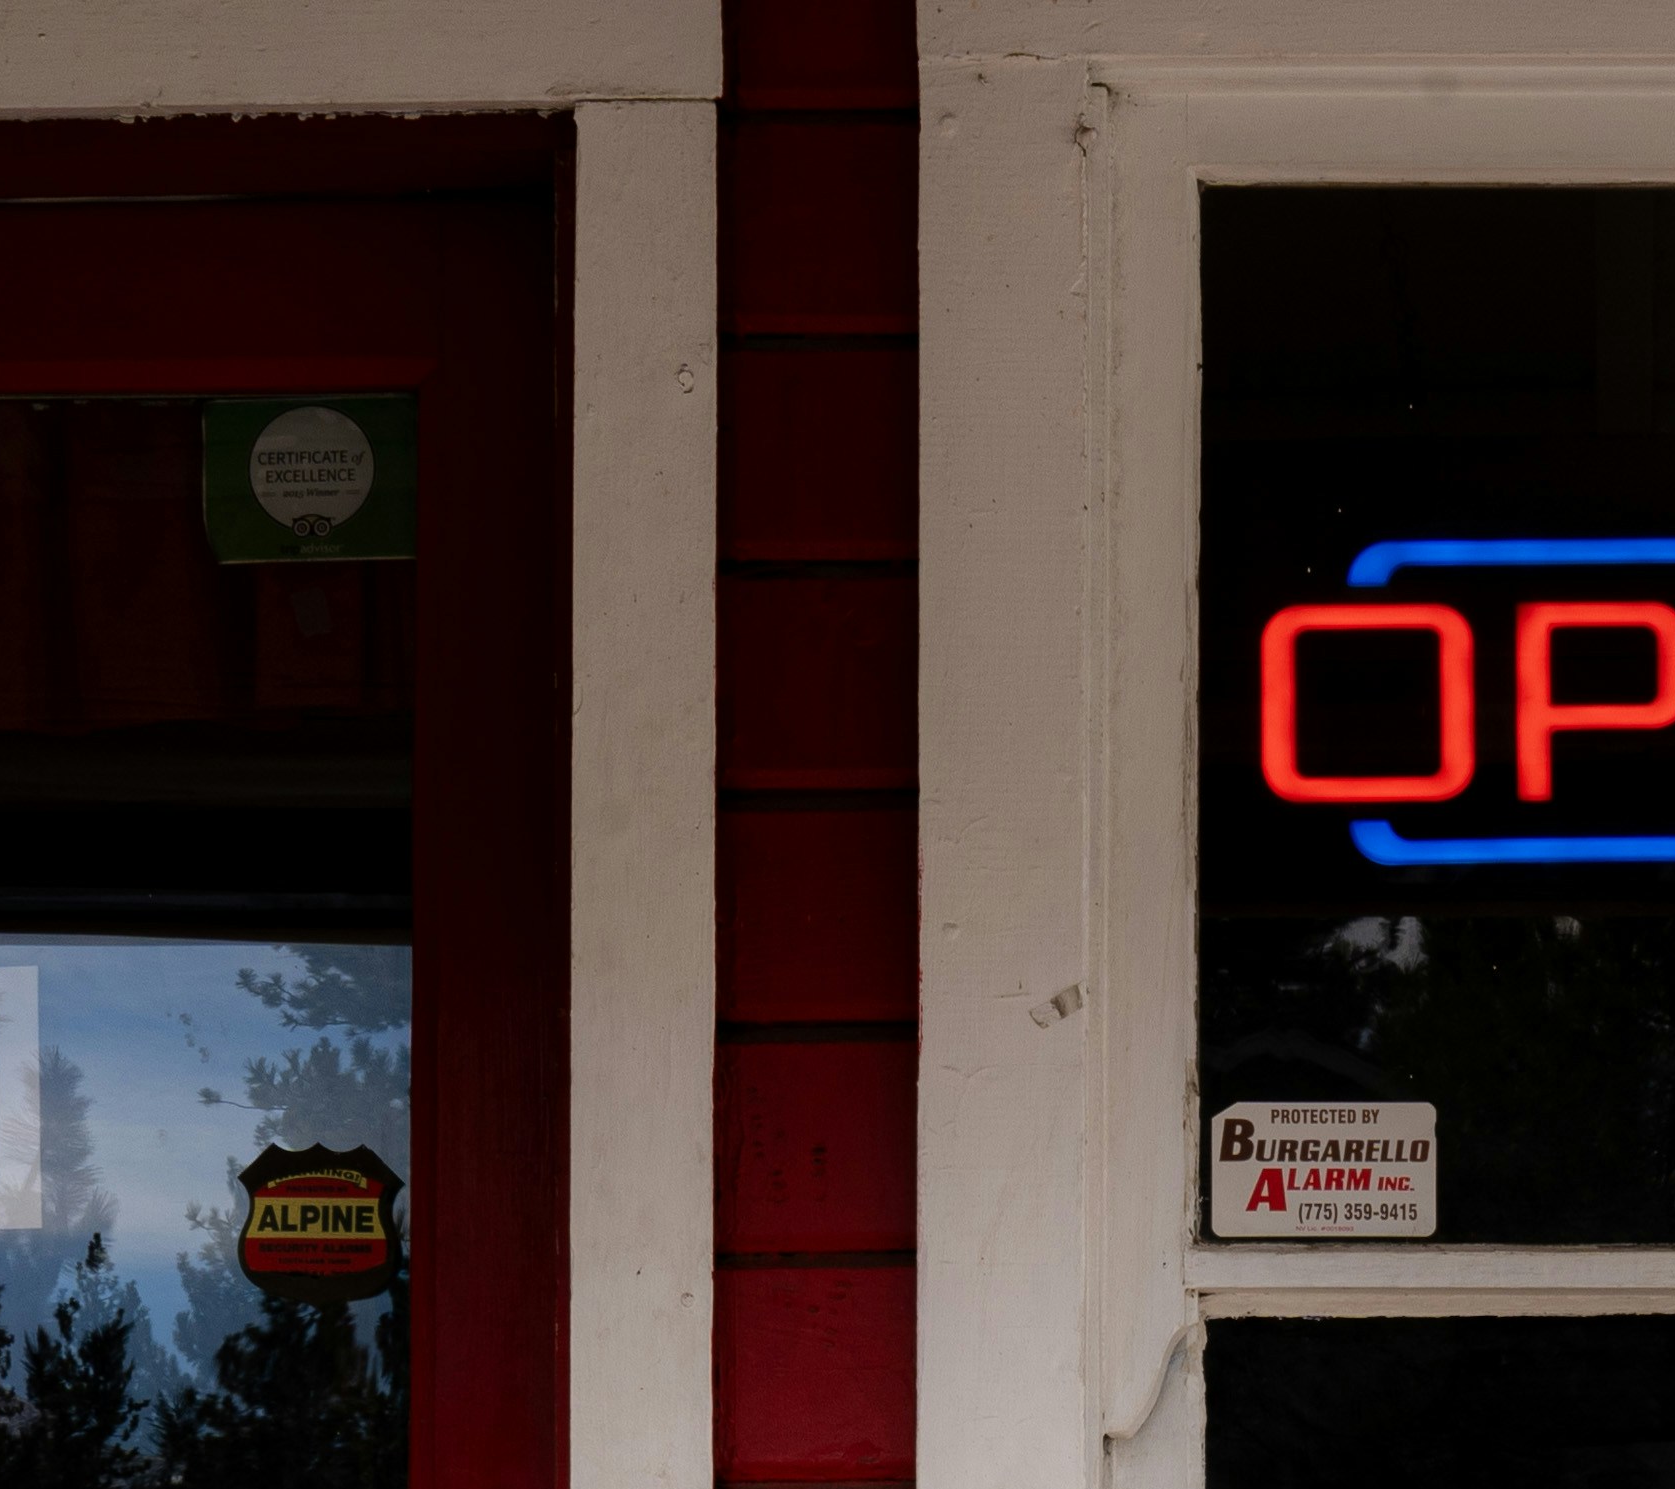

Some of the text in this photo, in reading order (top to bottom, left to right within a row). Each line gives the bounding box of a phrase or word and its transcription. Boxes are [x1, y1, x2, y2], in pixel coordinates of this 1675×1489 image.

[257, 450, 366, 466] CERTIFICATE of
[265, 468, 356, 484] EXCELLENCE
[1271, 1109, 1380, 1124] PROTECTED BY
[1219, 1118, 1430, 1162] BURGARELLO
[1245, 1168, 1415, 1212] ALARM INC.
[257, 1204, 375, 1233] ALPINE
[1298, 1203, 1418, 1224] (775) 359-9415
